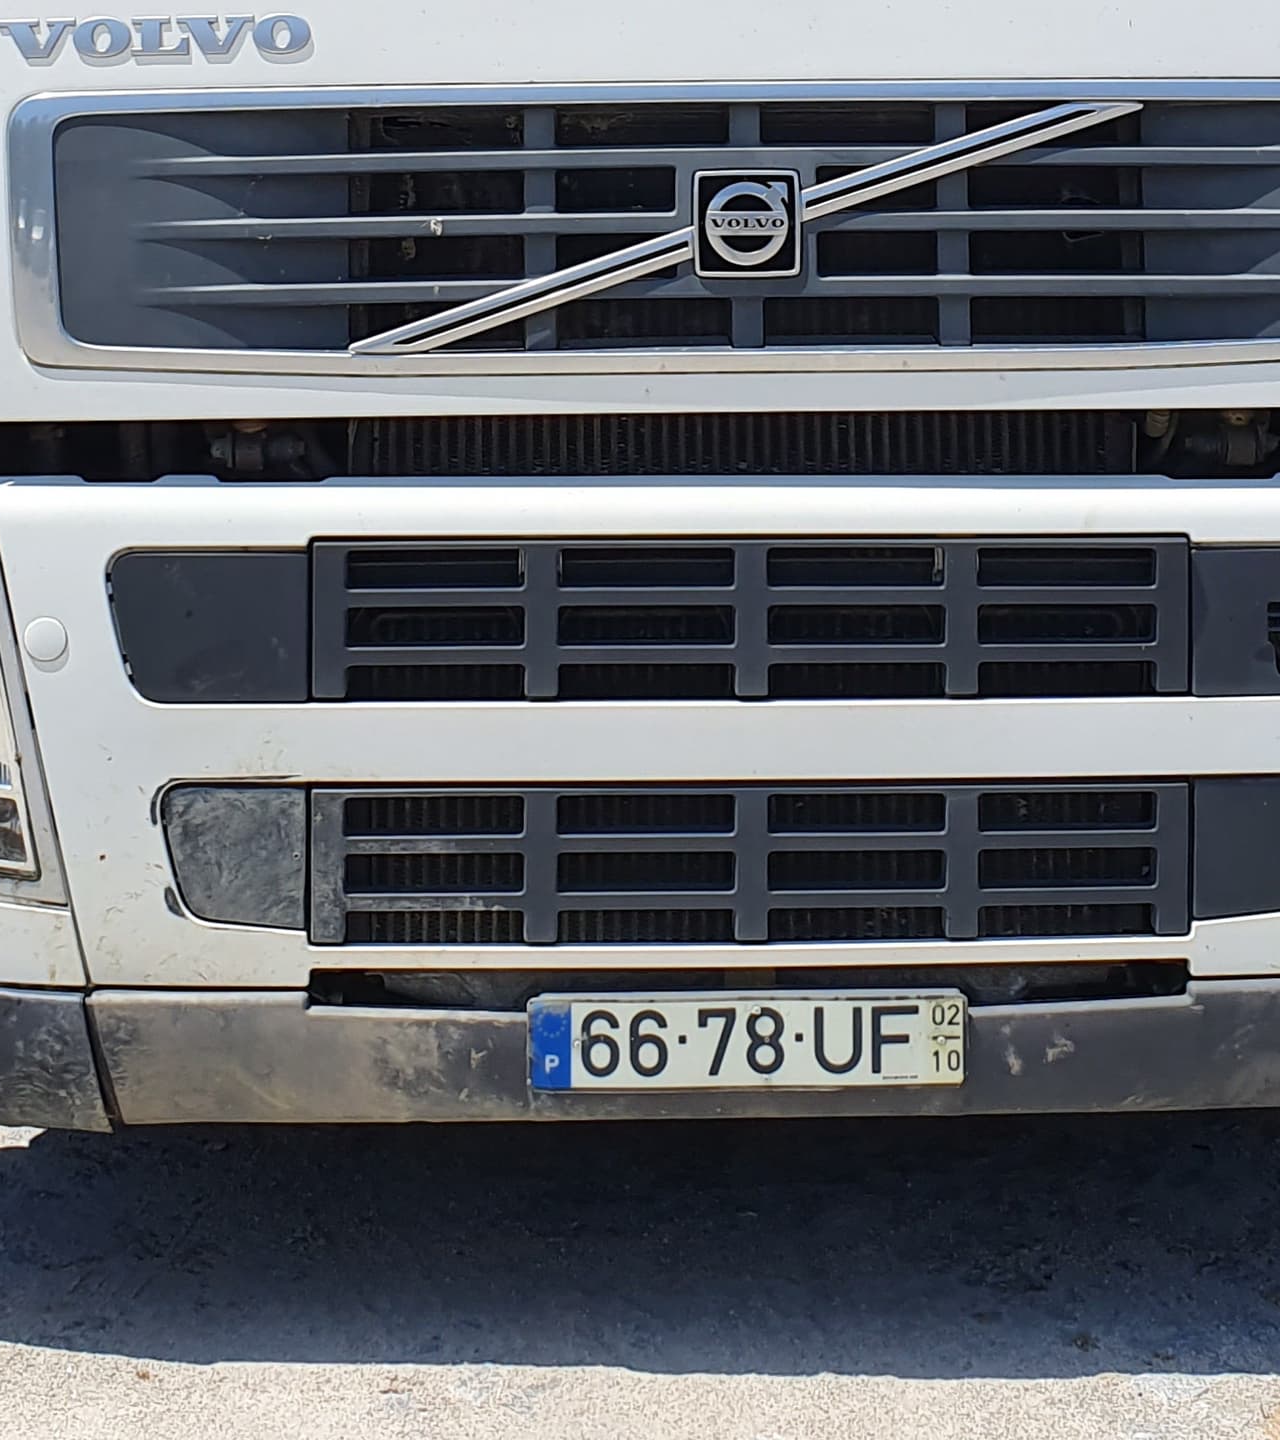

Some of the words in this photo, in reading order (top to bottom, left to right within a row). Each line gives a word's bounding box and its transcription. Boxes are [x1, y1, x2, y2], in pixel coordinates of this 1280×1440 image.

[710, 217, 785, 229] VOLVO
[931, 1004, 961, 1027] 02
[544, 1056, 560, 1075] P
[932, 1049, 961, 1073] 10
